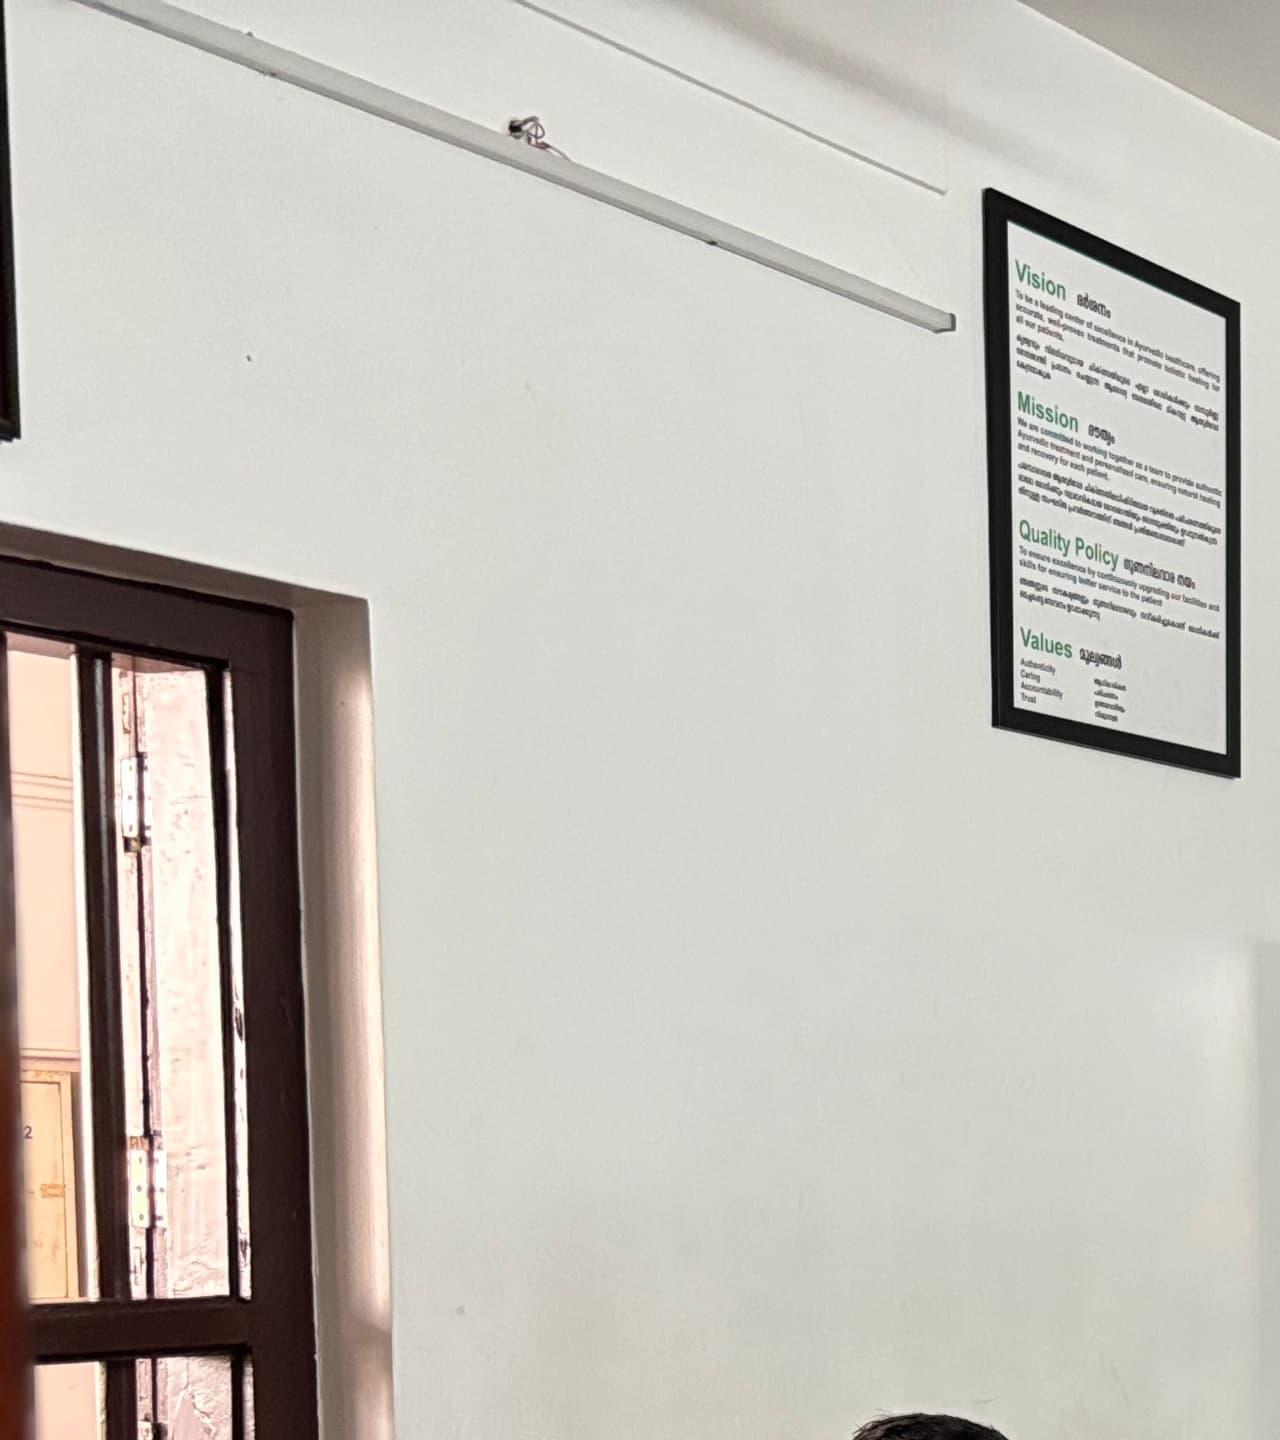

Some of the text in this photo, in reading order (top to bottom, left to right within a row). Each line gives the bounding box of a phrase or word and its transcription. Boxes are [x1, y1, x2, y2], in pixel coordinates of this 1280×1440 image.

[1015, 260, 1067, 301] Vision
[1018, 390, 1079, 433] Mission
[1020, 520, 1118, 572] Quality Policy
[1020, 626, 1073, 658] Values
